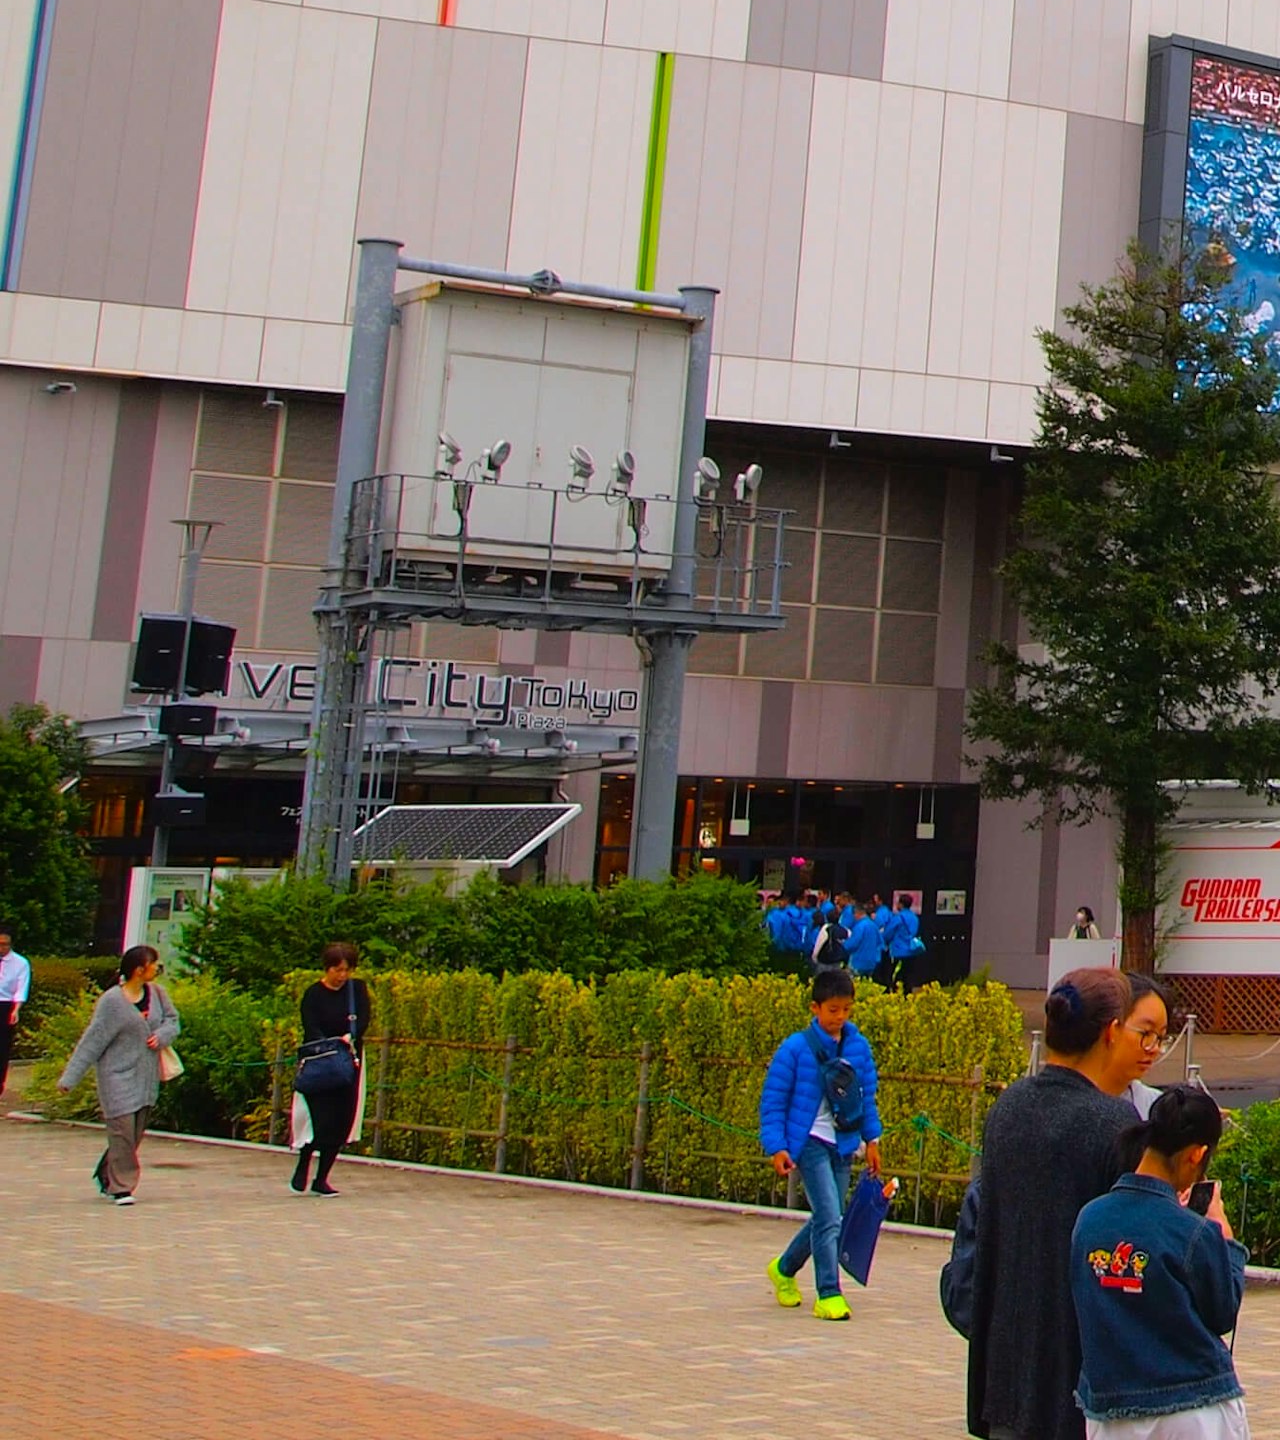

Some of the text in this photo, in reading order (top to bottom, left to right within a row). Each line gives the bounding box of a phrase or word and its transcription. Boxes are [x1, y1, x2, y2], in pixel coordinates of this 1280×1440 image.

[378, 658, 513, 728] City
[516, 712, 568, 729] Plaza
[1181, 878, 1261, 907] GUNDAM
